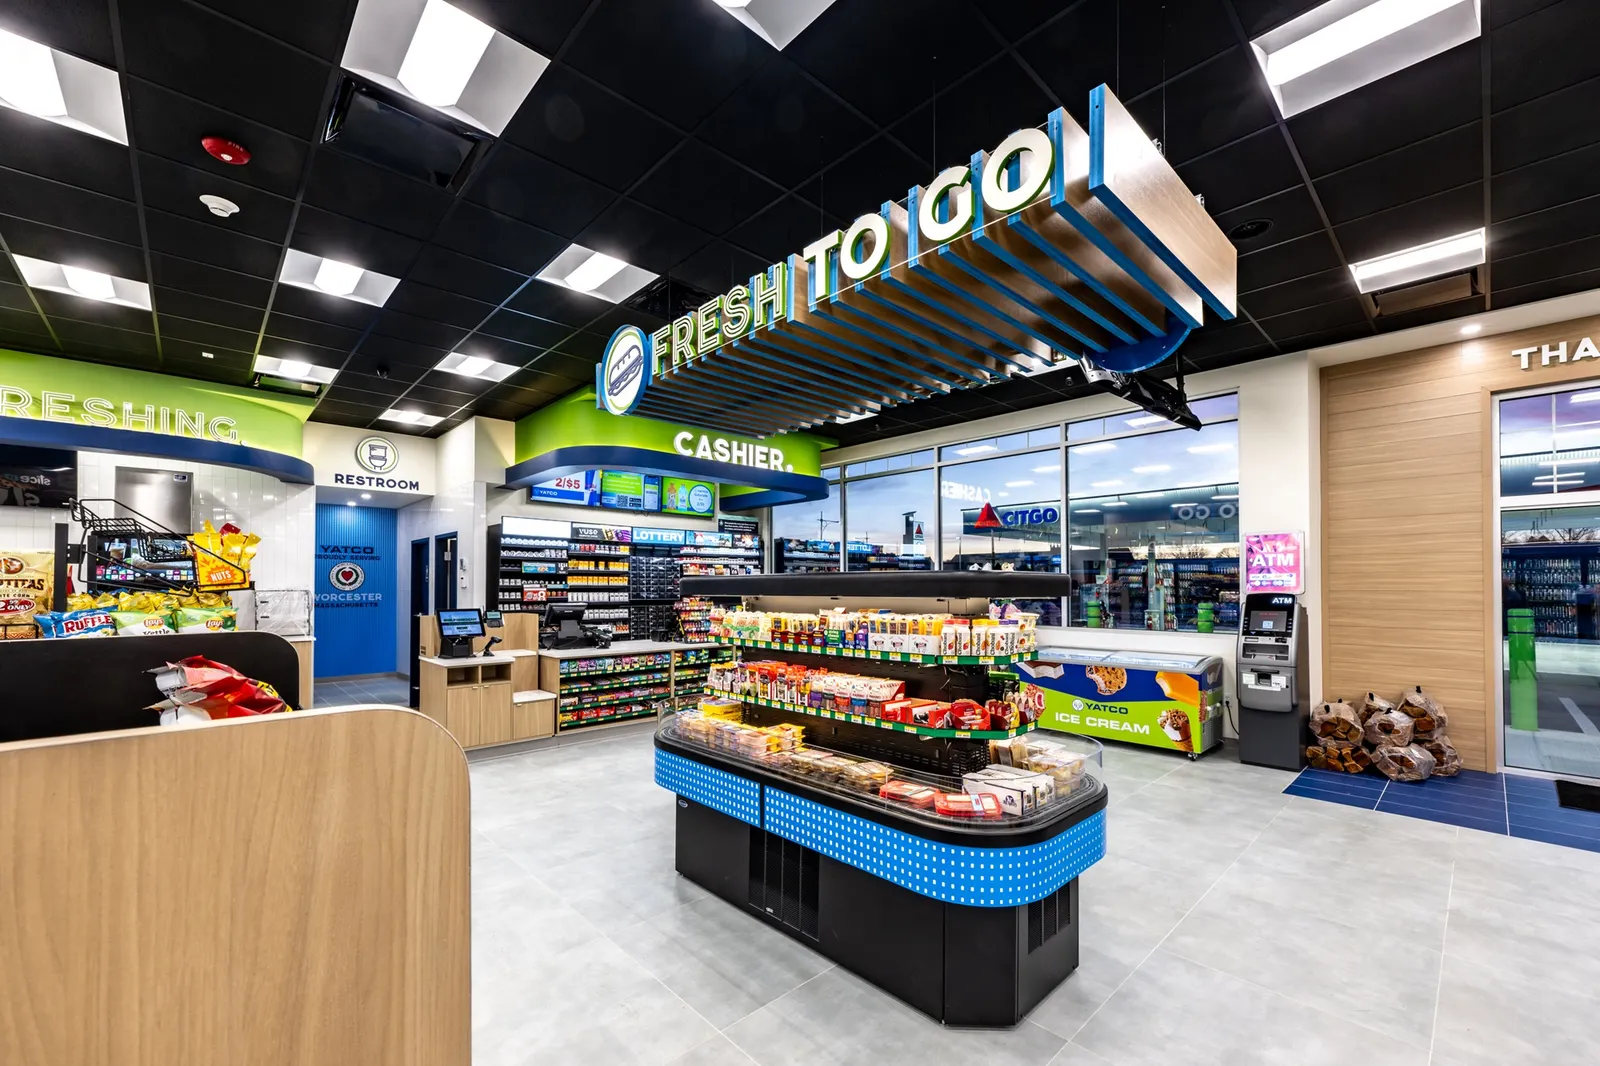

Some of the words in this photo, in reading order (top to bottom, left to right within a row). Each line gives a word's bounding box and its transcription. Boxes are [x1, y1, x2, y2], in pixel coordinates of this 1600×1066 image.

[652, 260, 788, 376] FRESH
[803, 212, 890, 301] TO
[918, 128, 1056, 243] GO
[673, 431, 794, 473] CASHIER.
[334, 473, 419, 491] RESTROOM
[555, 478, 581, 490] 2/$5
[1002, 507, 1059, 527] CITGO
[633, 530, 684, 543] LOTTERY
[320, 545, 374, 554] YATCO
[1252, 553, 1294, 567] ATM
[210, 570, 232, 582] NUTS
[63, 614, 113, 634] RUFFLE
[1085, 702, 1129, 715] YATCO
[1055, 712, 1080, 725] ICE
[1086, 716, 1150, 735] CREAM
